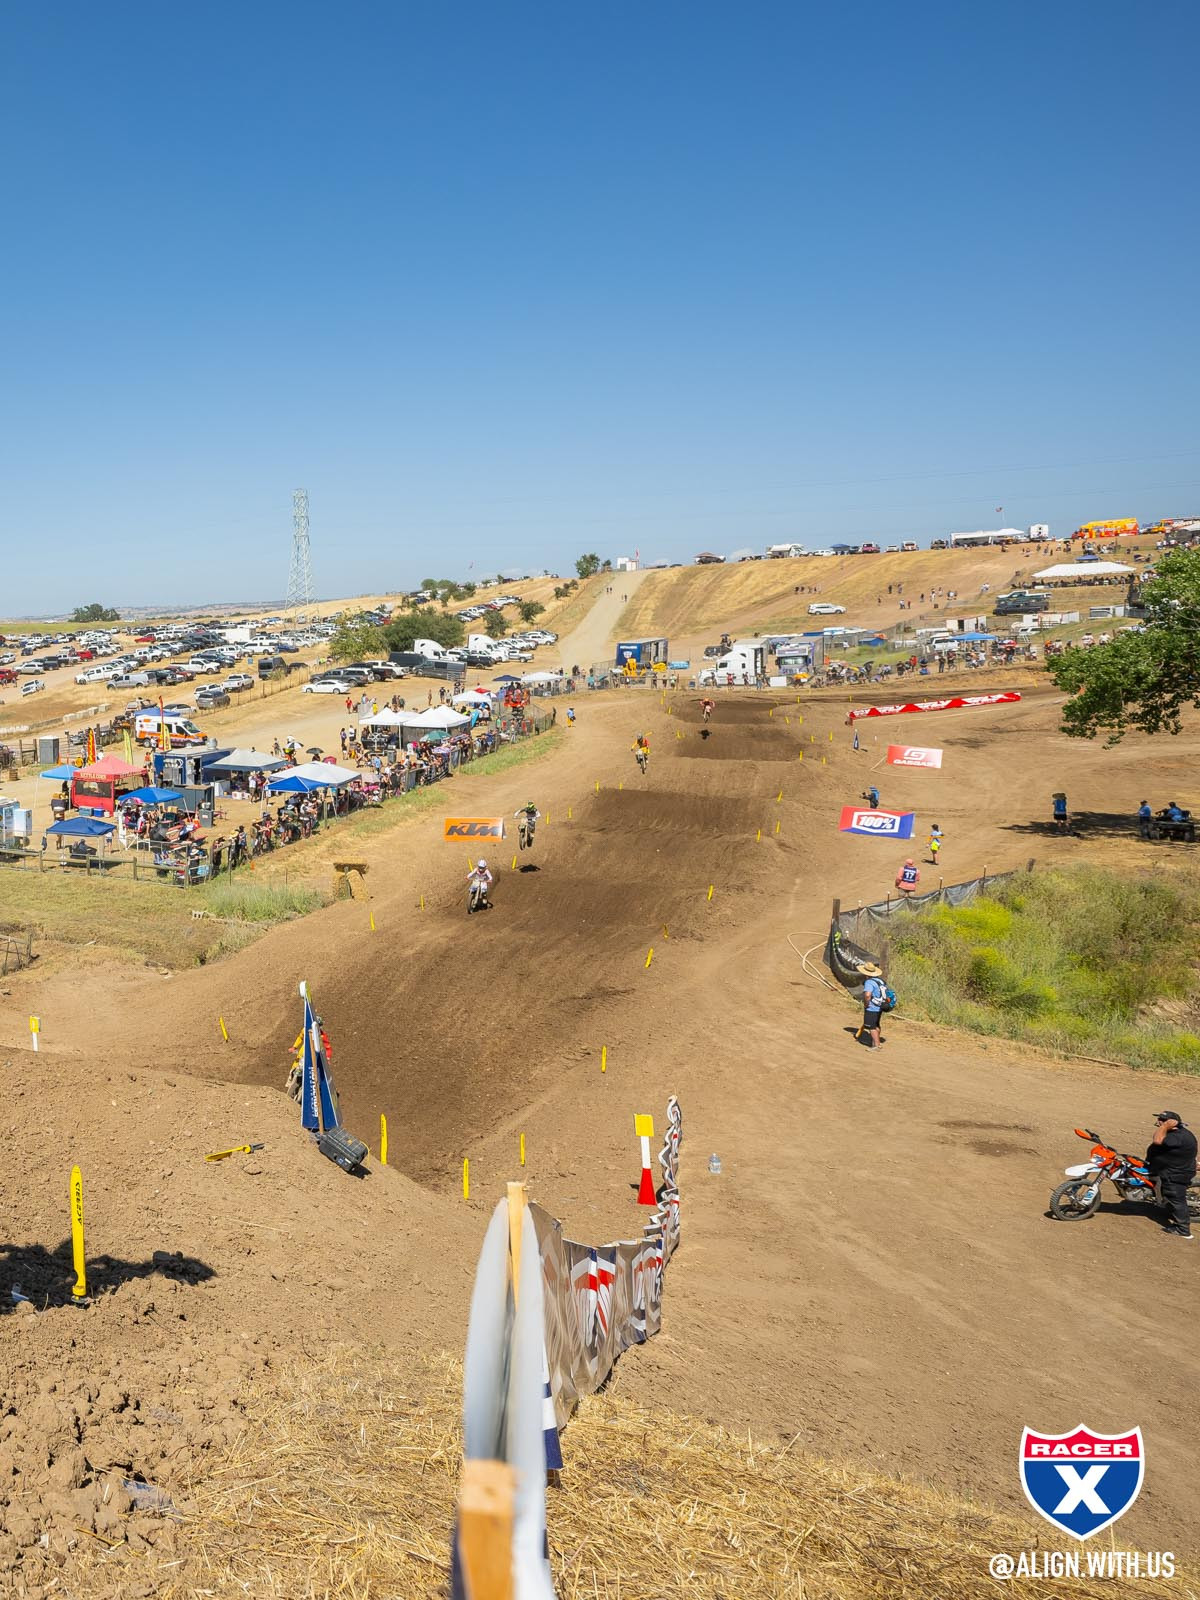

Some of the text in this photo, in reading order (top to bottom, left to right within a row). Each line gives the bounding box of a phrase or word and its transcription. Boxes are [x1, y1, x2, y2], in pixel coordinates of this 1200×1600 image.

[893, 759, 938, 767] GASGAS
[859, 815, 894, 829] 100%
[446, 822, 500, 836] KTM
[904, 871, 916, 879] 17
